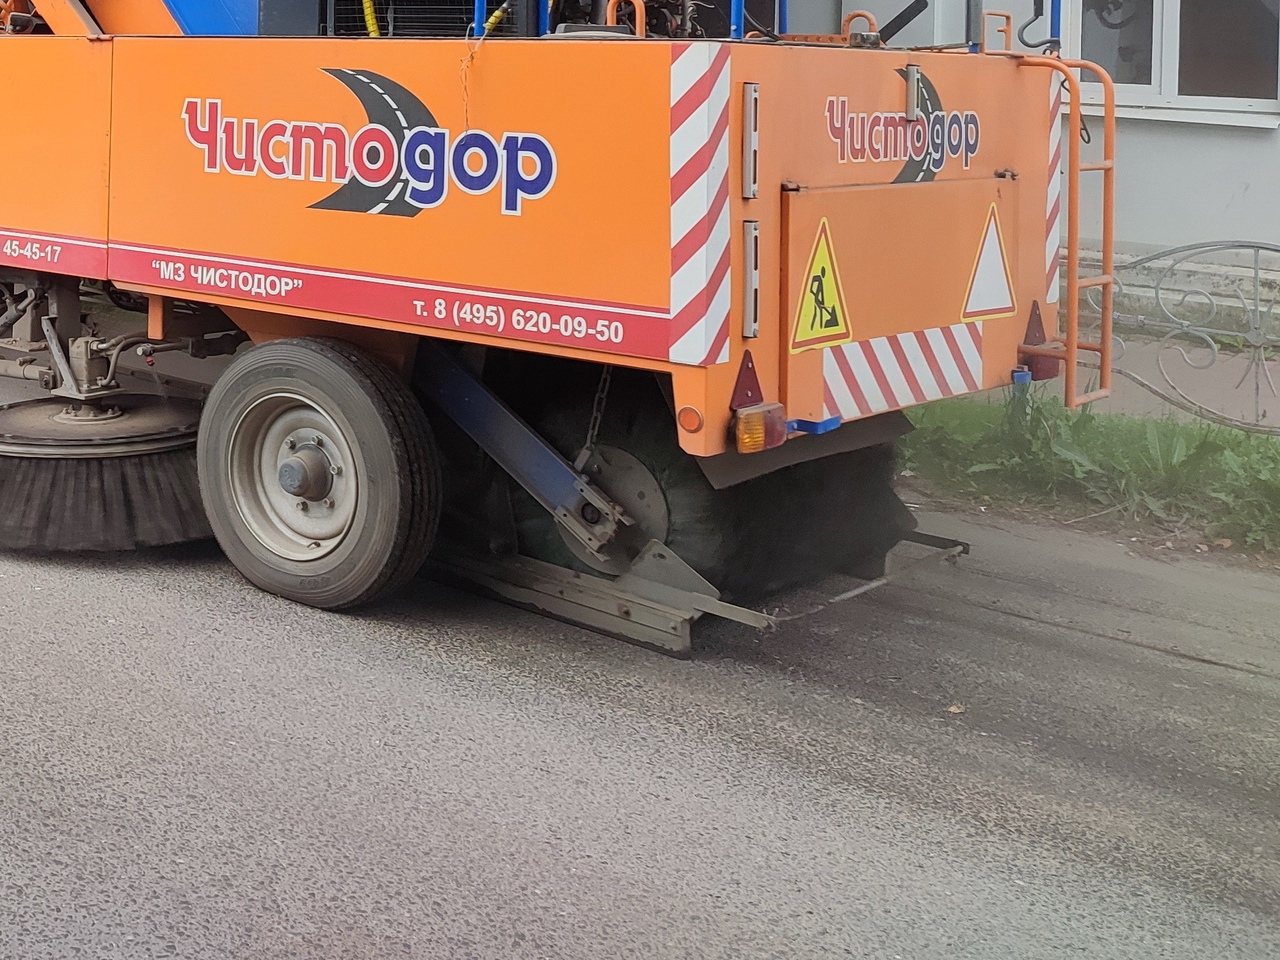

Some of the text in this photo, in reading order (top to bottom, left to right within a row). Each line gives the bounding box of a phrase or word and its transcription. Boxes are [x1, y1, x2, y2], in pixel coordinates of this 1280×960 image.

[181, 97, 558, 217] Чистодор
[824, 95, 981, 173] Чистодор
[2, 239, 62, 263] 45-45-17
[433, 298, 447, 319] 8
[452, 300, 505, 332] (495)
[511, 308, 624, 343] 620-09-50
